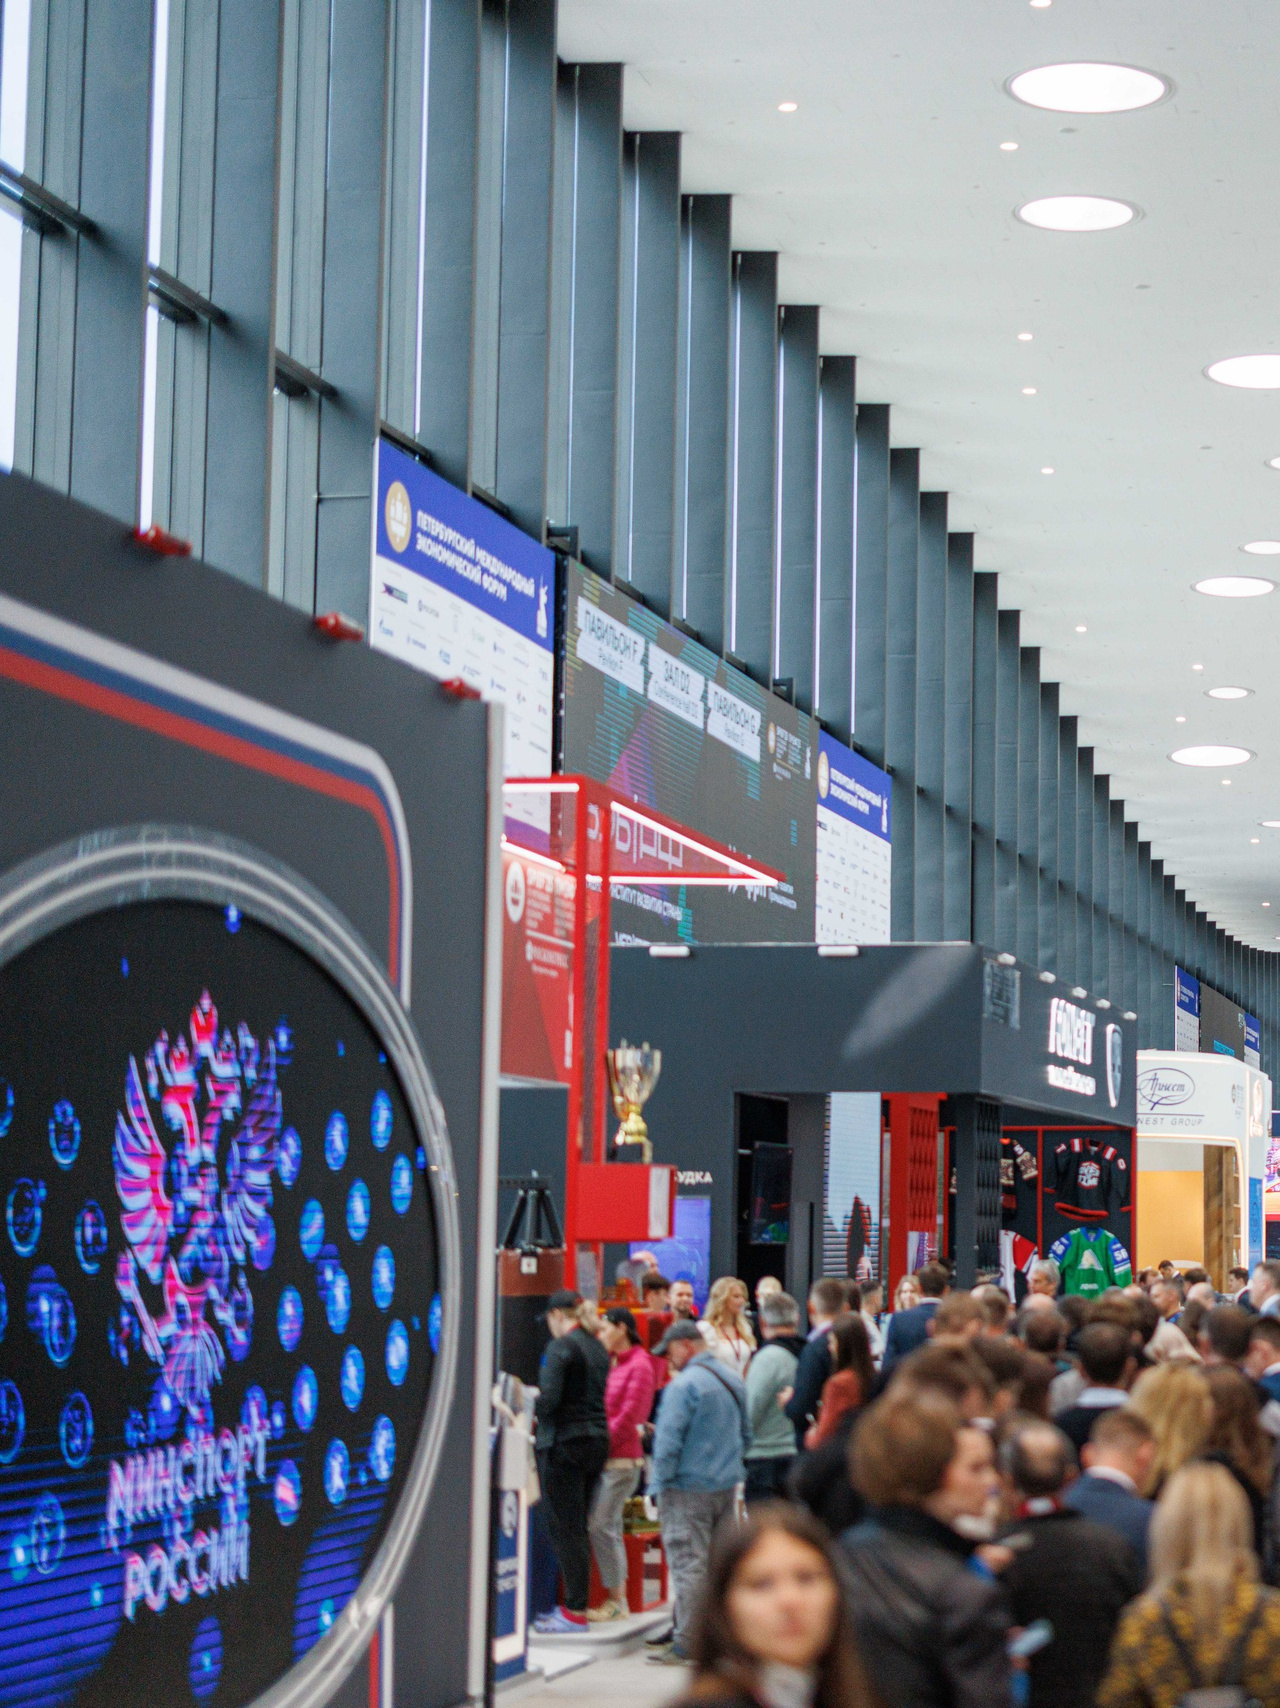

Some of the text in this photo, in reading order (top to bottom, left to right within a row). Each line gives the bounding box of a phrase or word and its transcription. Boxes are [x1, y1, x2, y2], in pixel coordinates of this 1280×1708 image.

[416, 509, 476, 560] ПЕТЕРБУРГСКИЙ
[416, 532, 508, 602] ЭКОНОМИЧЕСКИЙ ФОРУМ
[584, 611, 631, 657] ПАВИЛЬОН
[664, 661, 679, 686] ЗАЛ
[713, 690, 749, 728] ПАВИЛЬОН
[1171, 1118, 1203, 1127] GROUP
[674, 1170, 713, 1186] УДКА
[107, 1423, 270, 1529] МИНСПОРТ
[123, 1521, 250, 1624] РОССИИ
